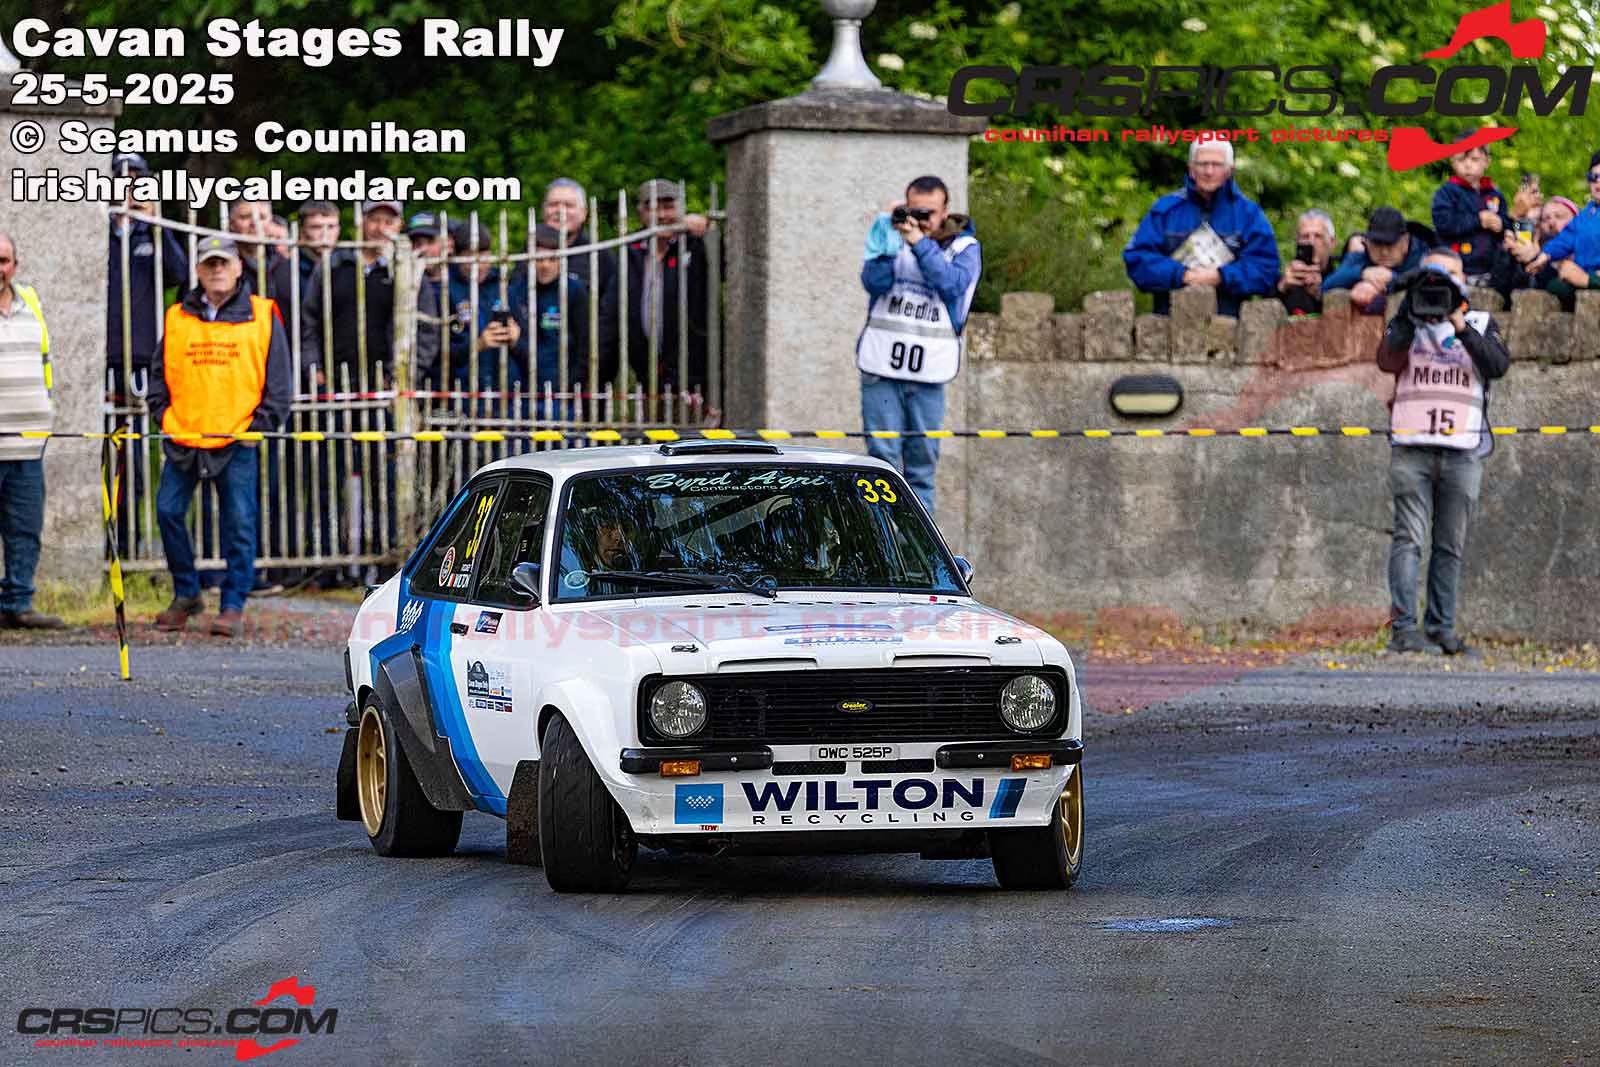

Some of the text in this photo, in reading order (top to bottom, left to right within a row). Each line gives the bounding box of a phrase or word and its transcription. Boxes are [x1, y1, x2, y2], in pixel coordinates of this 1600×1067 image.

[888, 296, 940, 322] Media
[890, 342, 924, 372] 90
[1413, 366, 1470, 387] Media
[1426, 408, 1456, 436] 15
[646, 470, 825, 492] Byrd Agri
[857, 479, 897, 503] 33
[818, 747, 893, 759] OWC 525P
[741, 778, 985, 812] WILTON
[752, 810, 975, 825] RECYCLING
